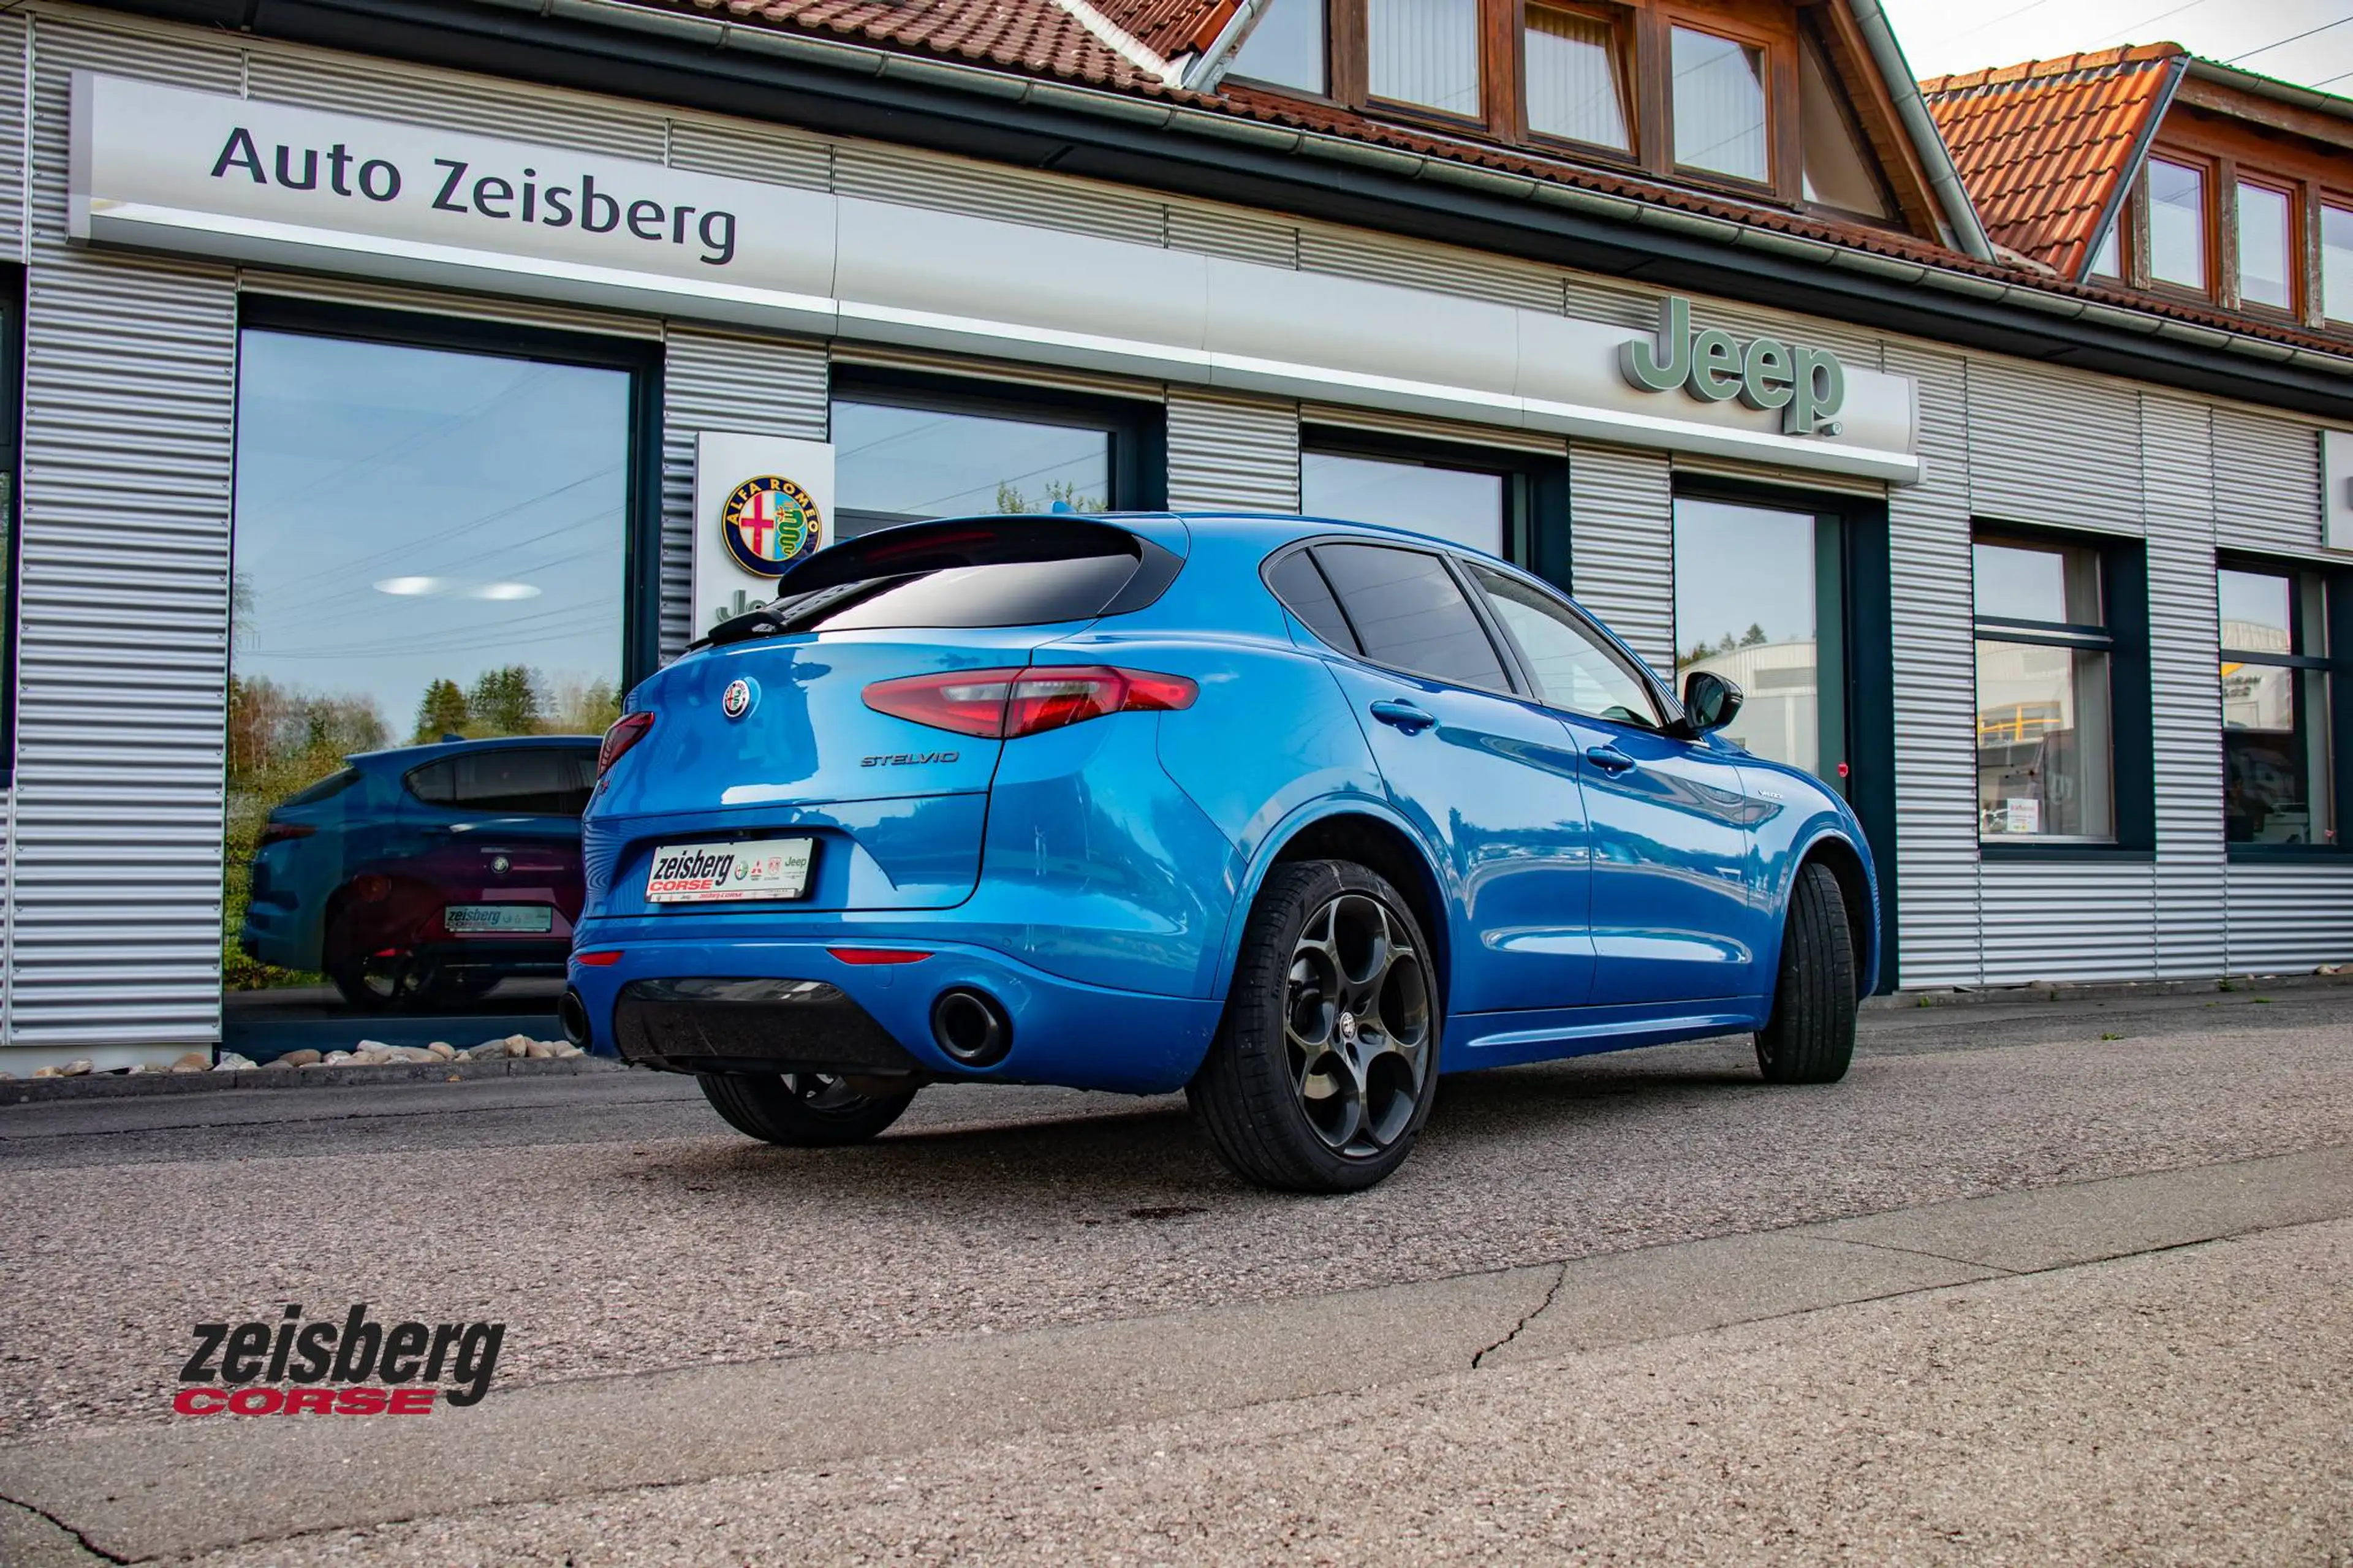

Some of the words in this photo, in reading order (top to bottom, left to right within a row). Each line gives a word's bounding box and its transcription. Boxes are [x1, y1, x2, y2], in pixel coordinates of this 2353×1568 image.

[211, 126, 402, 202] Auto
[431, 157, 736, 266] Zeisberg
[1619, 295, 1845, 436] Jeep
[726, 482, 763, 525] ALFA
[770, 479, 818, 532] ROMEO
[860, 751, 960, 767] STELVIO
[653, 849, 735, 886] zeisberg
[785, 856, 807, 868] Jeep
[649, 879, 713, 892] CORSE
[448, 908, 501, 925] zeisberg
